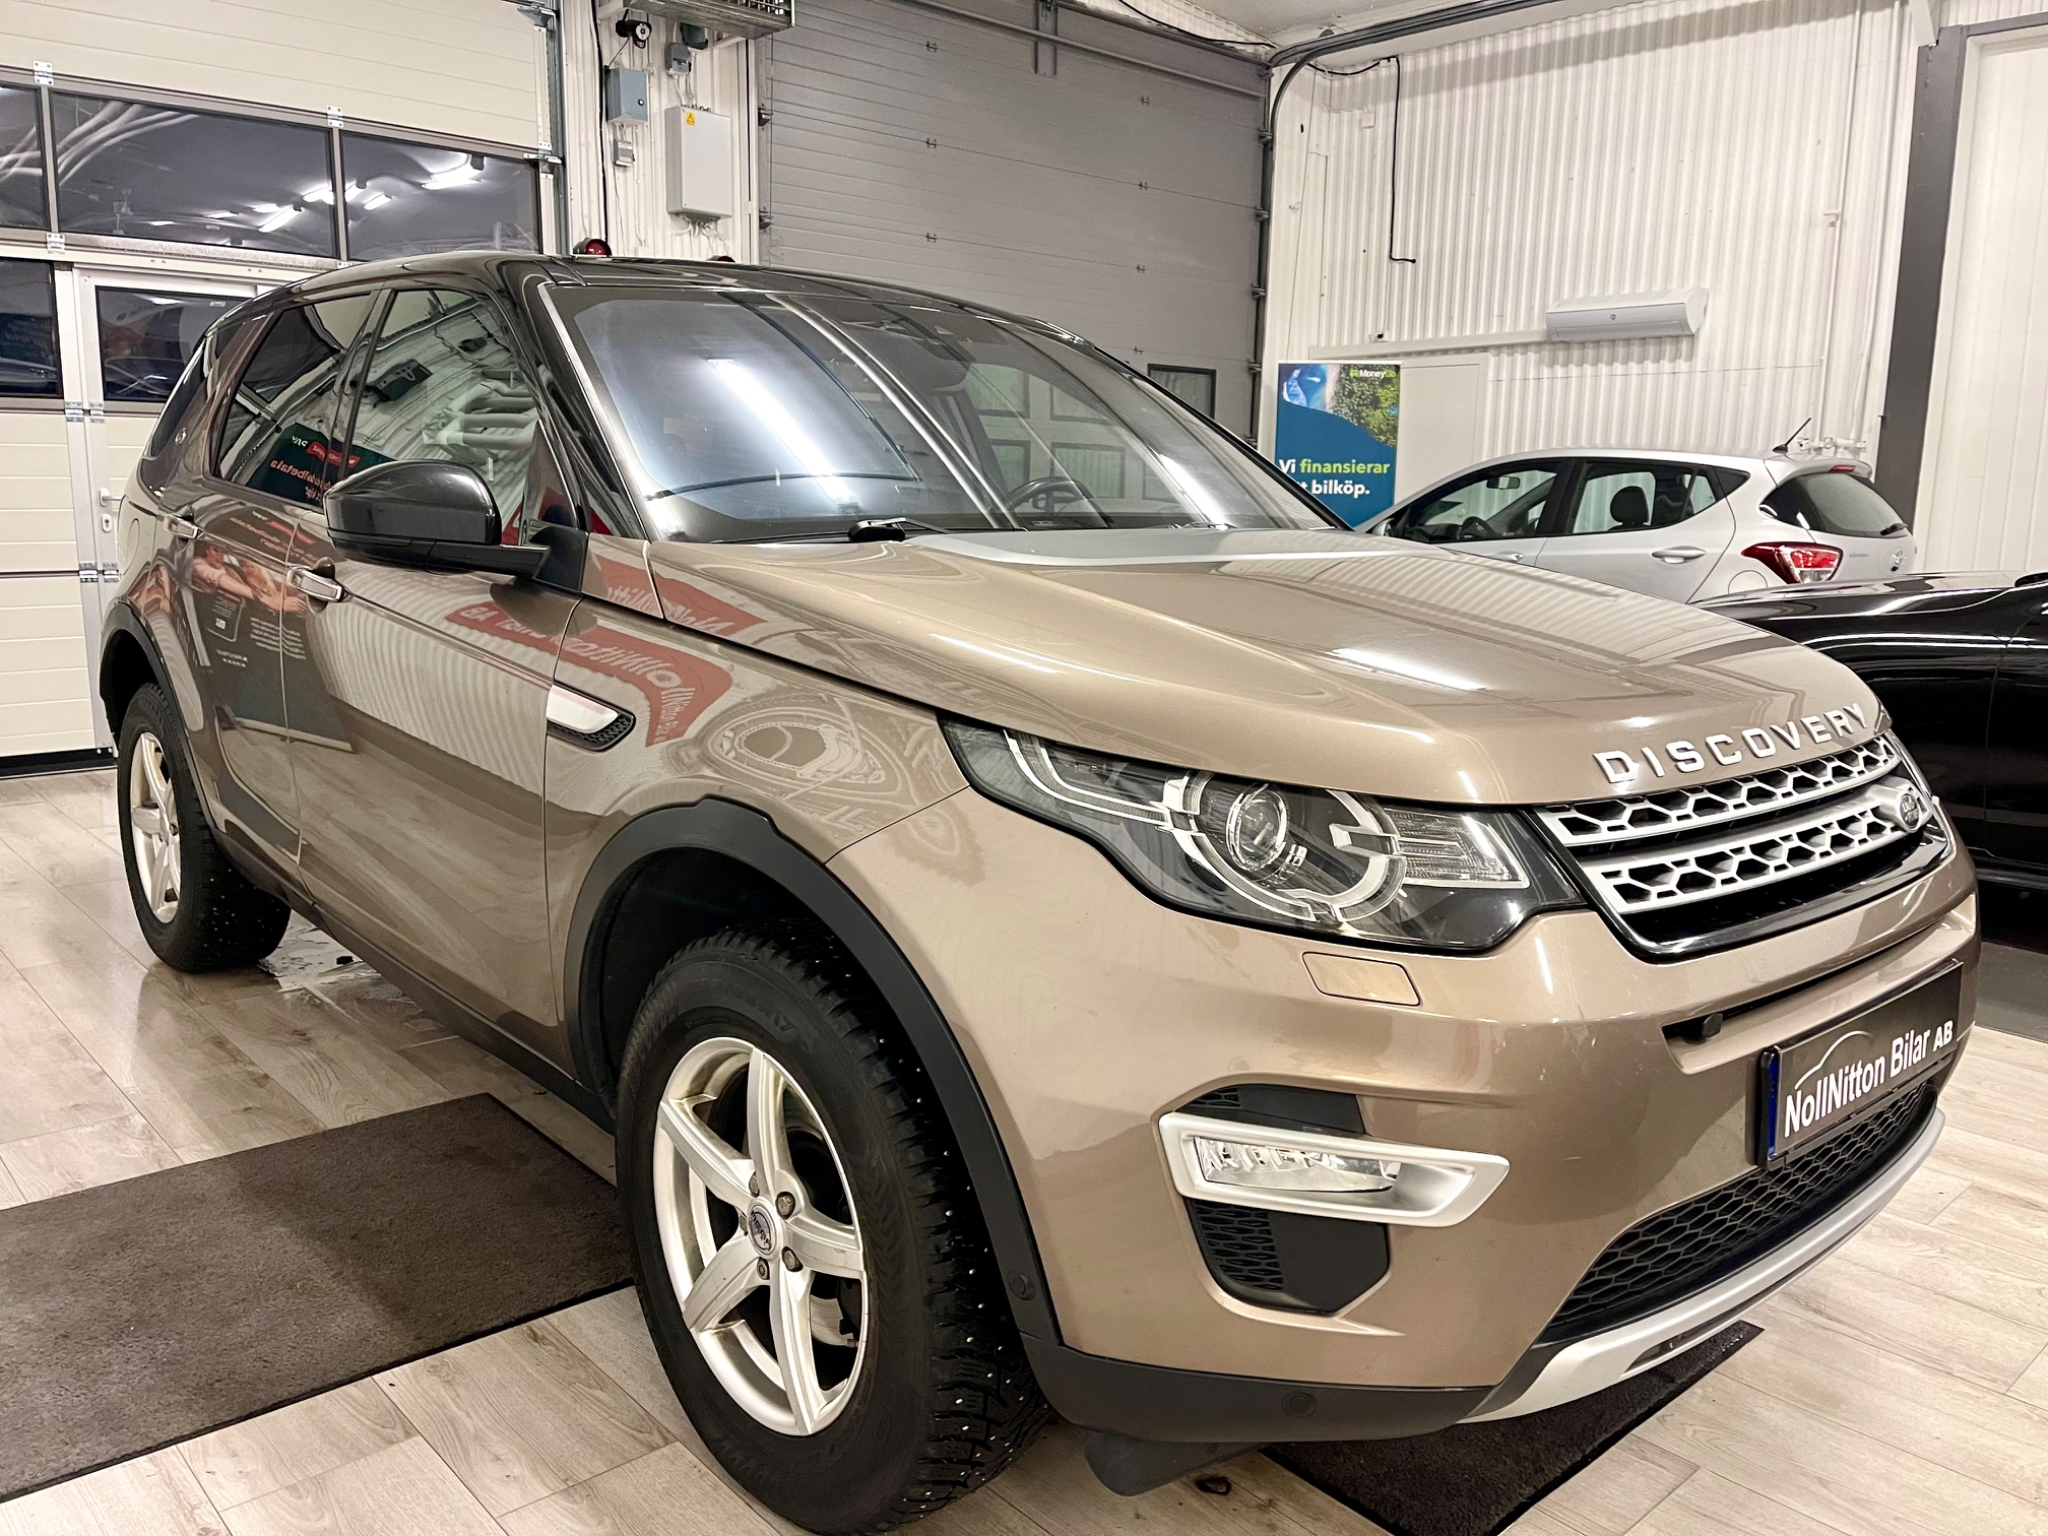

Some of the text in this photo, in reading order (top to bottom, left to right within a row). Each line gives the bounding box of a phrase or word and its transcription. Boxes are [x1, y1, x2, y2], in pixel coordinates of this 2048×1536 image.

[1279, 458, 1391, 474] Vi finansierar
[1311, 480, 1371, 499] bilköp.
[1593, 702, 1869, 784] DISCOVERY
[1784, 1020, 1954, 1138] NollNitton Bilar AB
